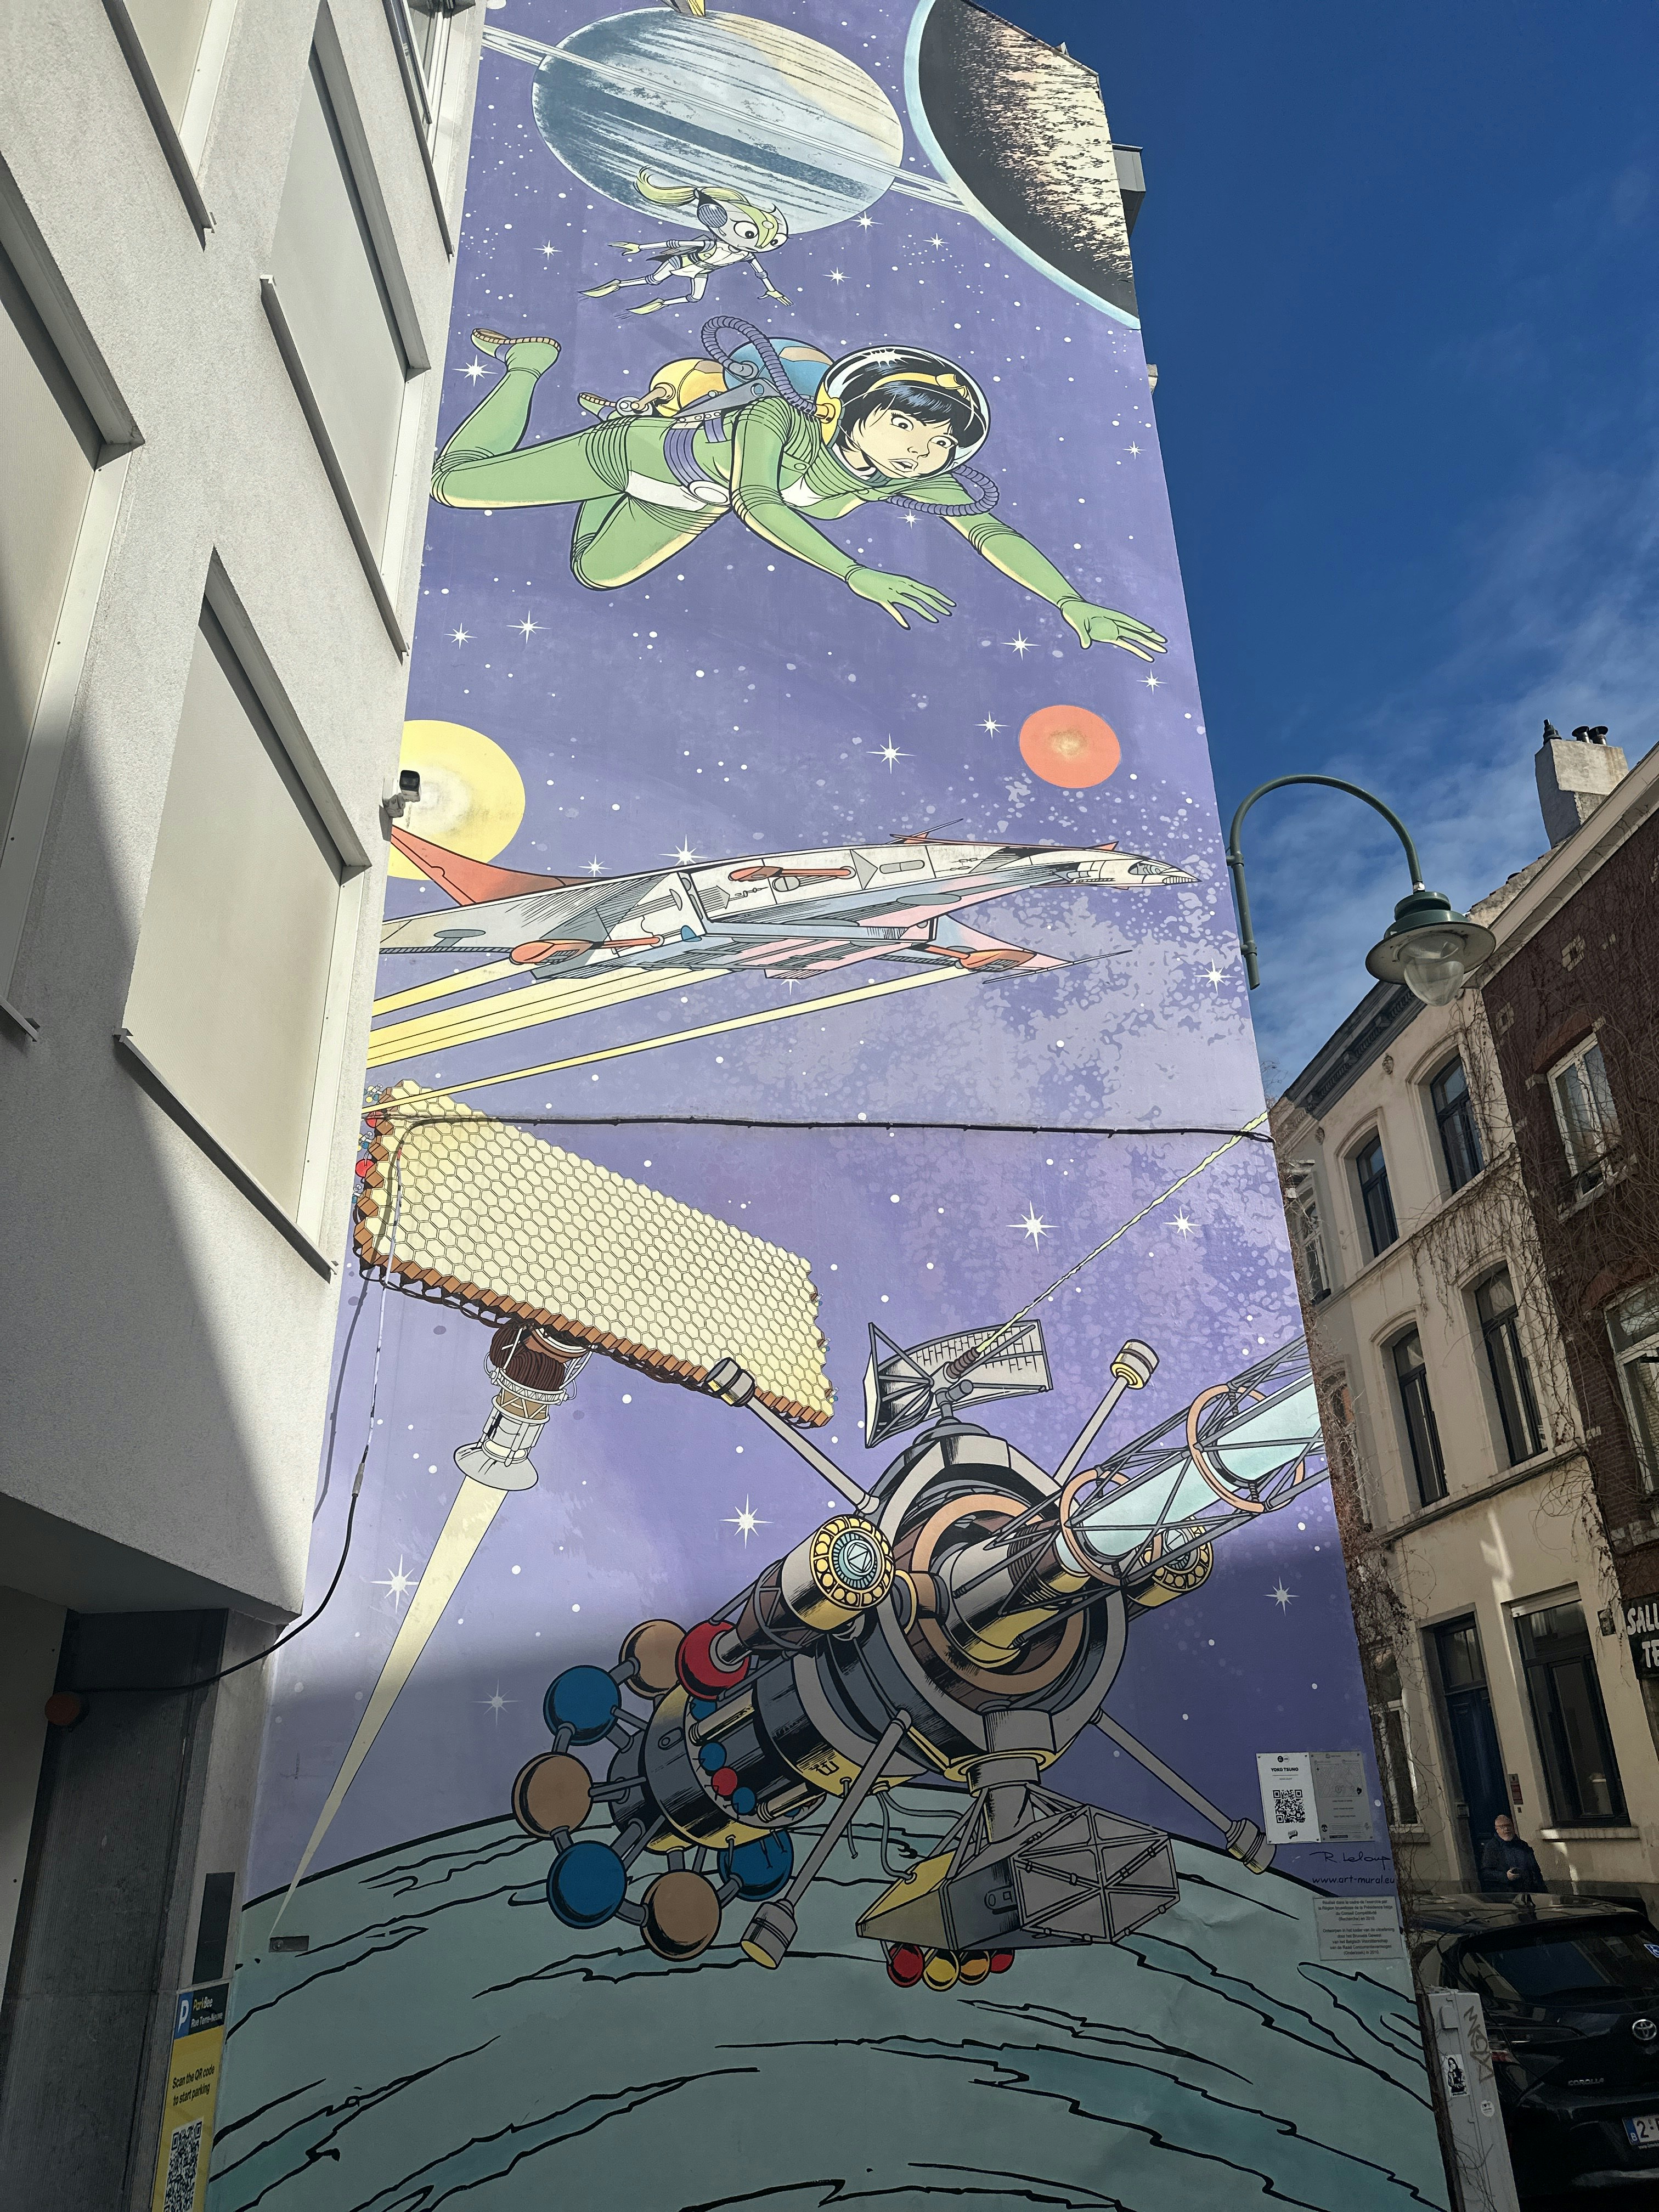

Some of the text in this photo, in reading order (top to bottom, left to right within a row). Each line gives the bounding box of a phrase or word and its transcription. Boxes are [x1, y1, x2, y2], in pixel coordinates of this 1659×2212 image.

[1312, 1875, 1395, 1884] www.art-mural.eu
[193, 1997, 213, 2011] ParkBee
[173, 2076, 185, 2089] Scan
[195, 2068, 202, 2080] QR
[203, 2064, 215, 2076] code
[173, 2084, 210, 2106] to start parking
